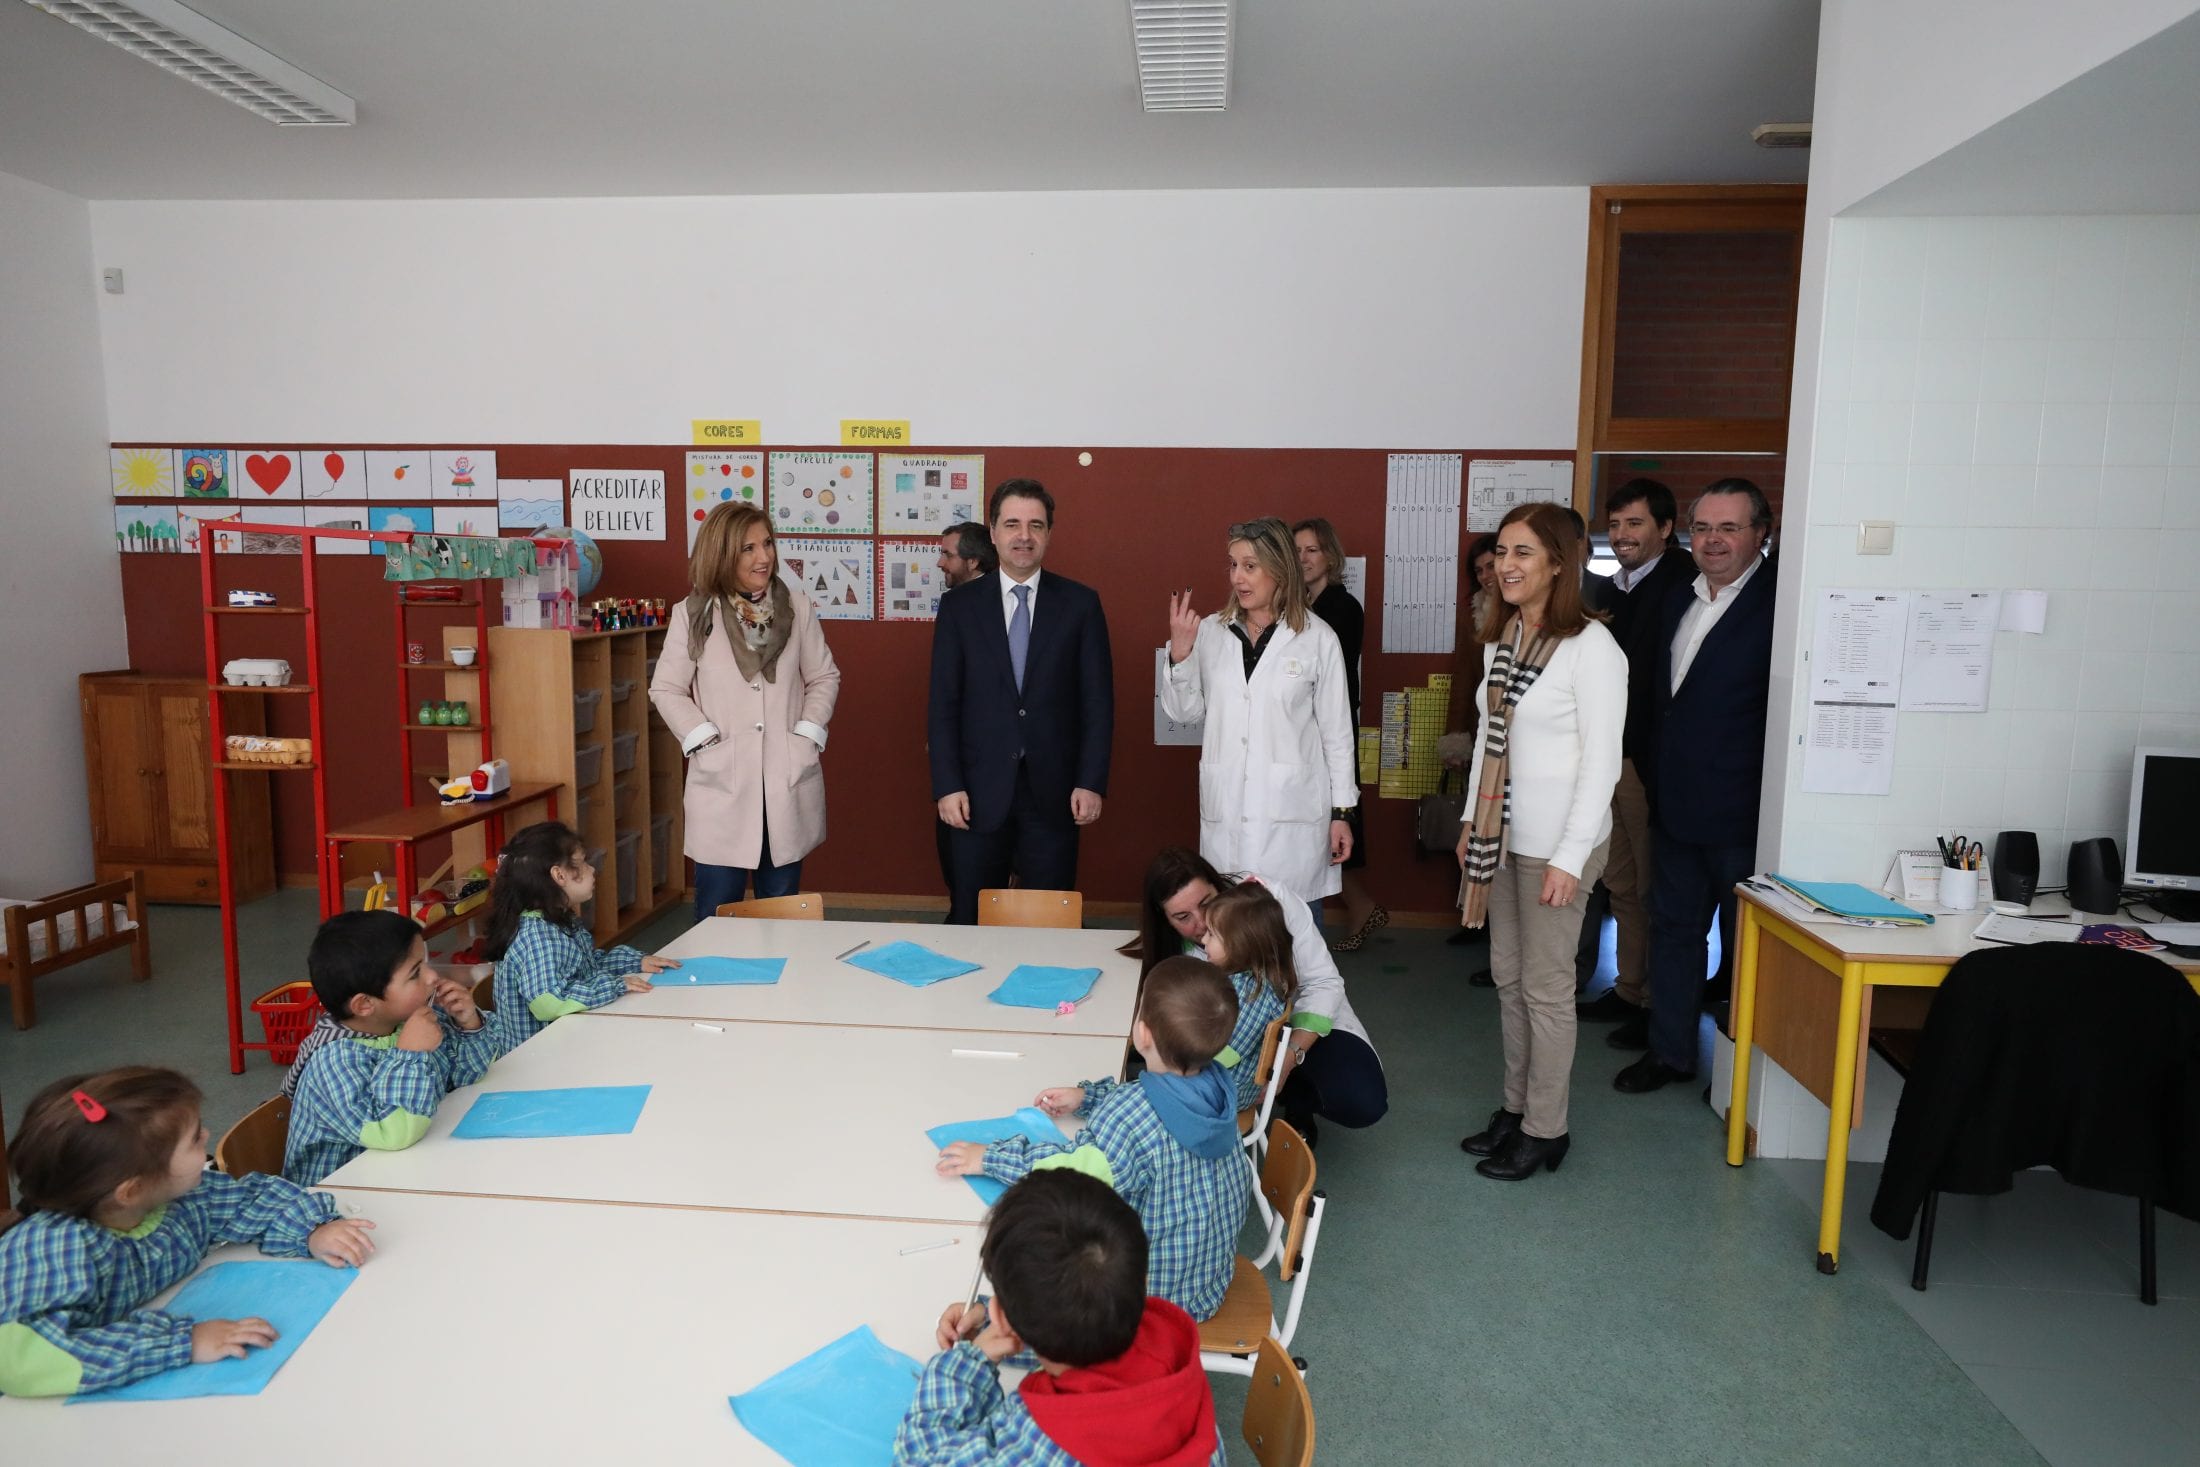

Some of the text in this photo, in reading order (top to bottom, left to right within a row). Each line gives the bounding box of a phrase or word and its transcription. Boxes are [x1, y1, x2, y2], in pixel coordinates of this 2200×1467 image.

[703, 425, 744, 438] CORES
[851, 425, 902, 440] FORMAS
[902, 459, 948, 467] QUADRADO
[571, 477, 662, 500] ACREDITAR
[585, 510, 655, 532] BELIEVE
[1168, 721, 1175, 732] 2
